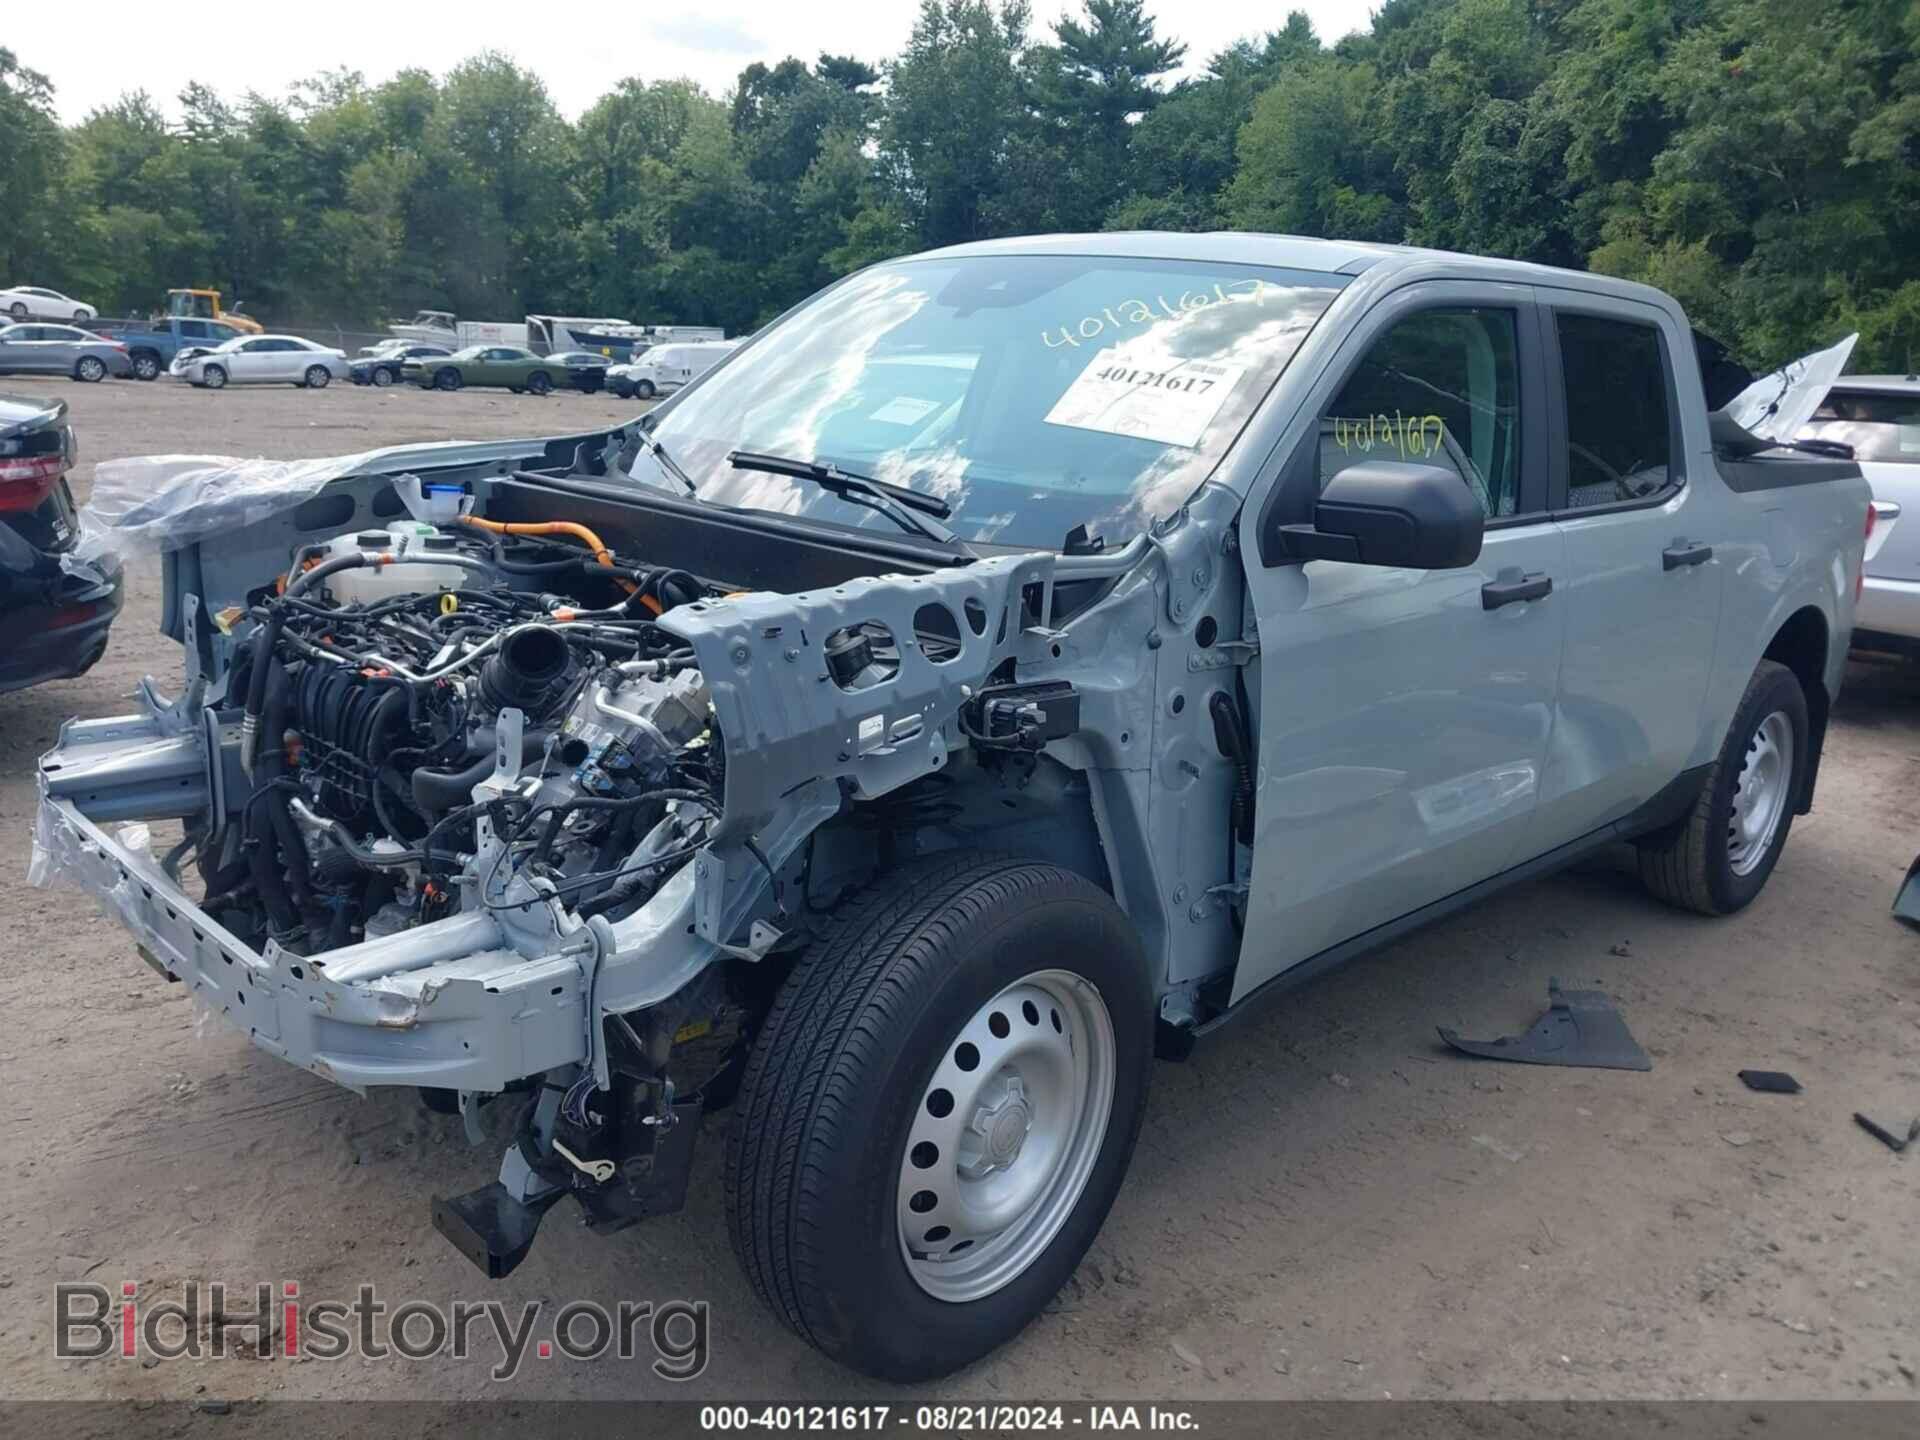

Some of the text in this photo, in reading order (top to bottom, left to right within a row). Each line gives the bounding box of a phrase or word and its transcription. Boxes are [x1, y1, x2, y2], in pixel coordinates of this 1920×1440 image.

[1041, 279, 1266, 348] 40121617
[1096, 366, 1216, 395] 40121617
[1335, 409, 1443, 460] 40121617
